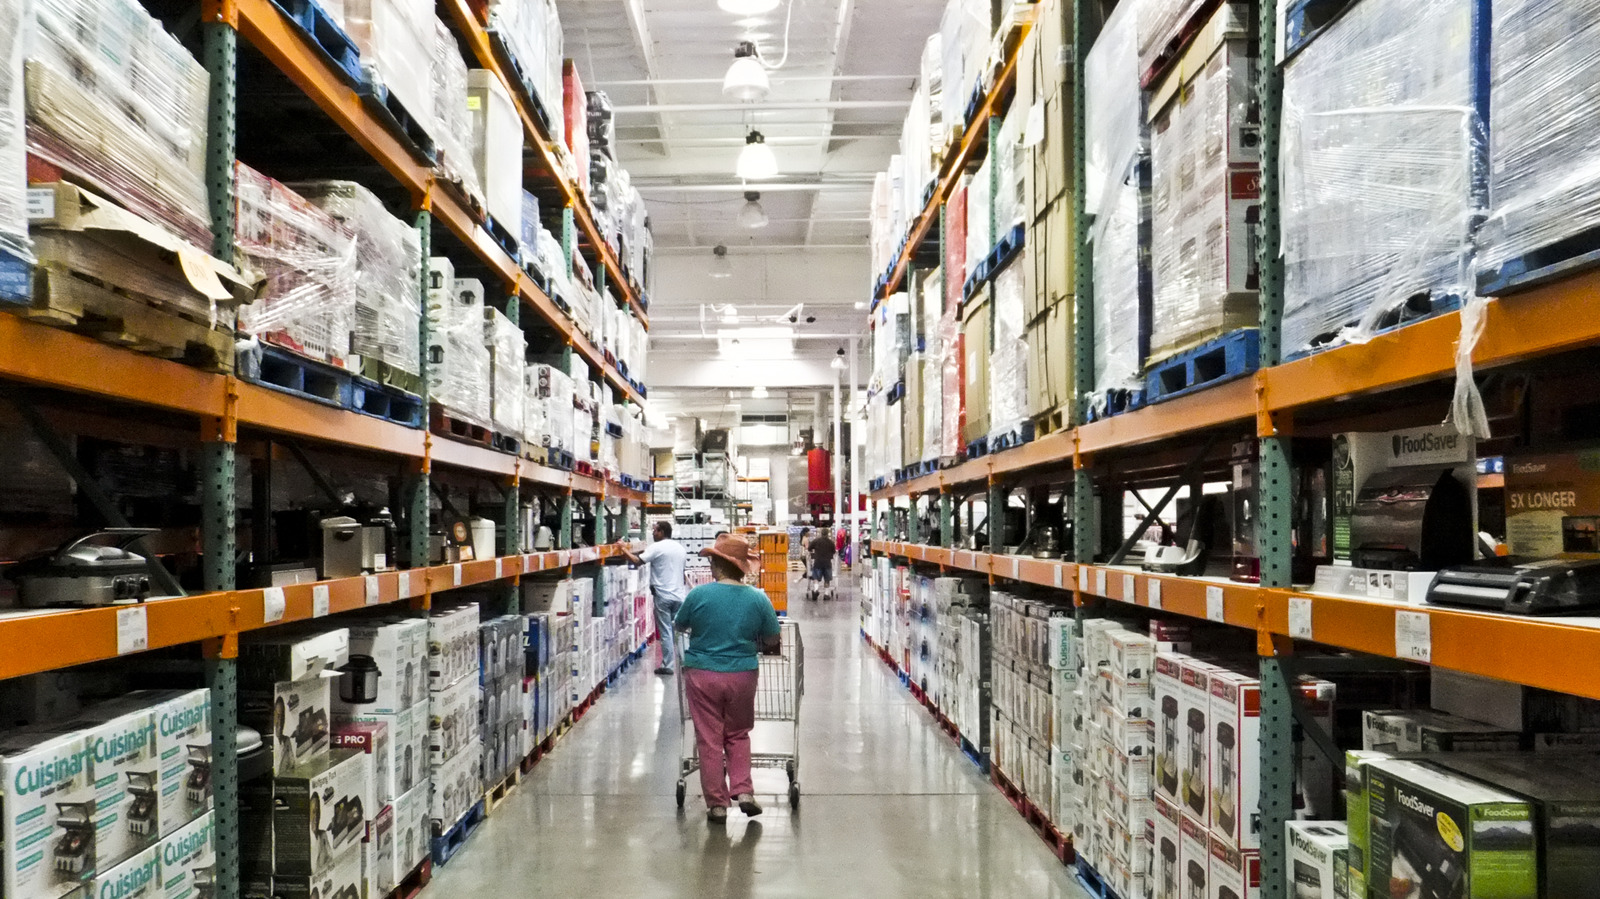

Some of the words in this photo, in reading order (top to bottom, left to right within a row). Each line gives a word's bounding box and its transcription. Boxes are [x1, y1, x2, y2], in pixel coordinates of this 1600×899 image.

[1402, 432, 1459, 453] FoodSaver
[1513, 462, 1546, 474] FoodSaver
[1528, 491, 1576, 508] LONGER
[1060, 624, 1068, 667] Cuisinart
[159, 701, 212, 737] Cuisinart
[94, 722, 156, 763] Cuisinart
[344, 735, 366, 744] PRO
[15, 746, 94, 796] Cuisinart
[1398, 789, 1435, 818] FoodSaver
[1484, 808, 1529, 817] FoodSaver
[164, 819, 216, 866] Cuisinart
[1295, 832, 1327, 865] FoodSaver
[100, 853, 162, 899] Cuisinart
